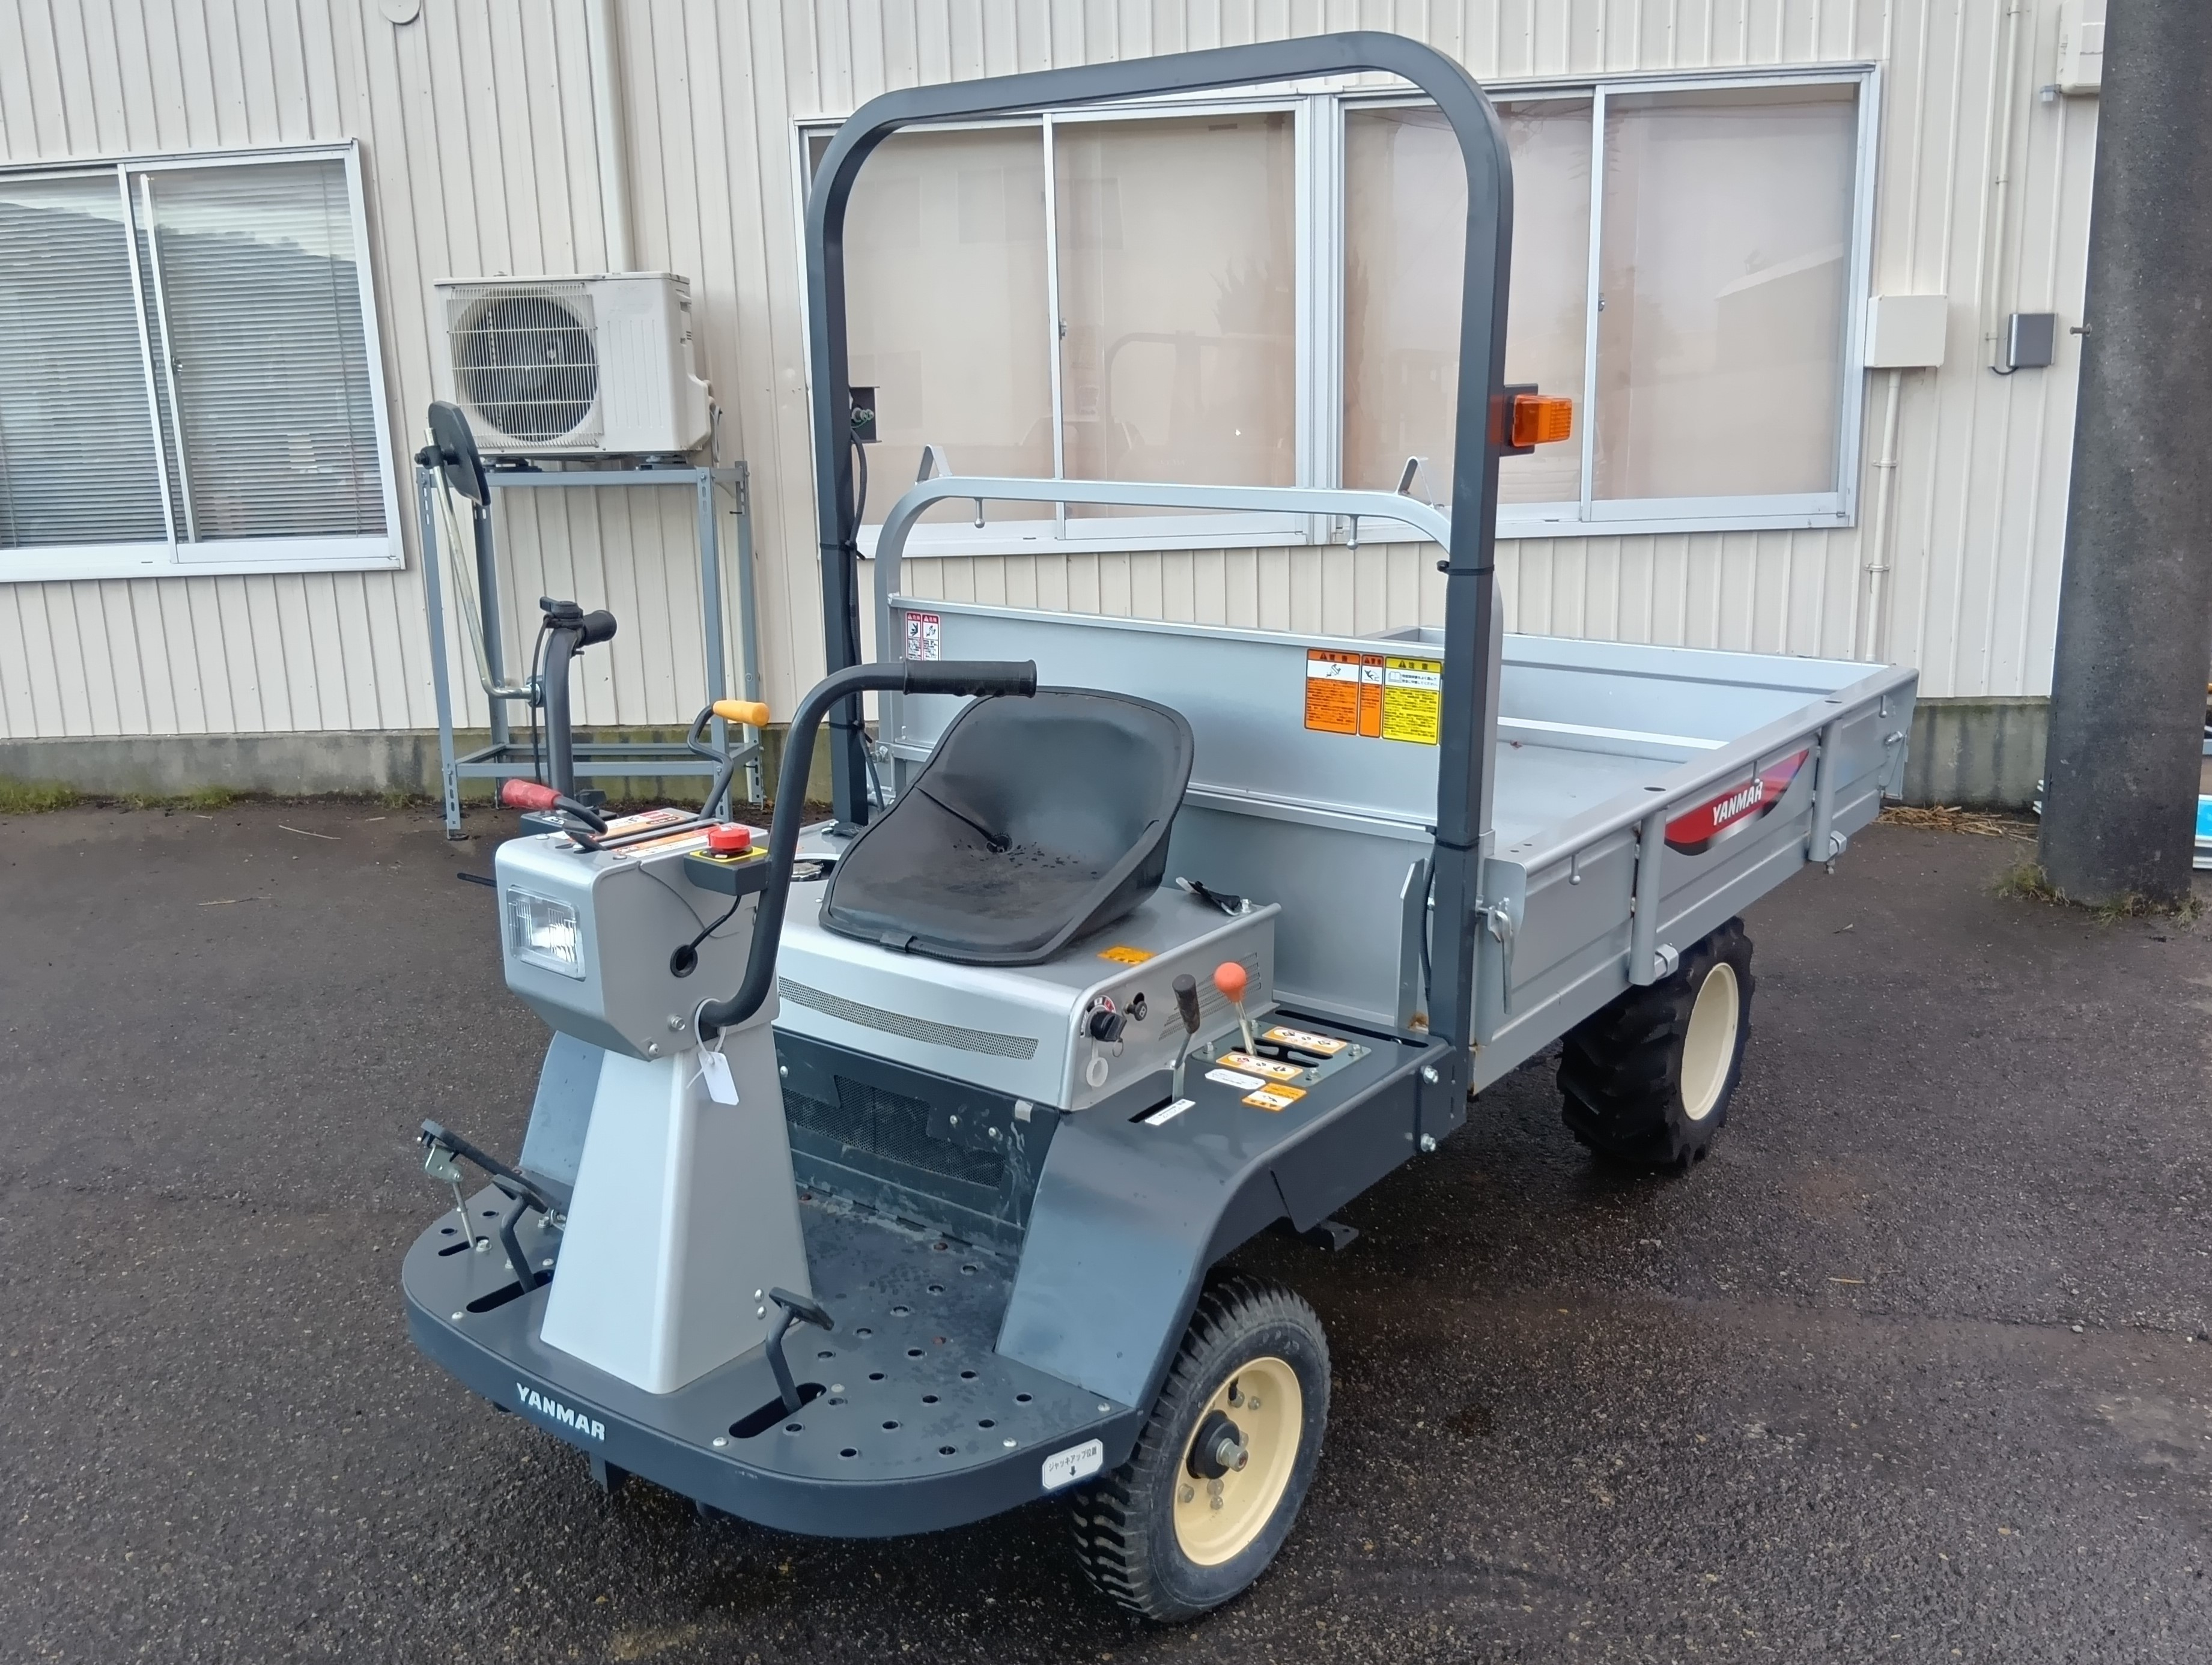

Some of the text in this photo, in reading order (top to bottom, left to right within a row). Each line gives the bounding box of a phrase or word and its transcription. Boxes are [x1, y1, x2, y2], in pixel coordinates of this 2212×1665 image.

[1712, 781, 1763, 826] YANMAR
[516, 1382, 606, 1441] YANMAR
[1049, 1446, 1097, 1472] ジャッキアップ位置
